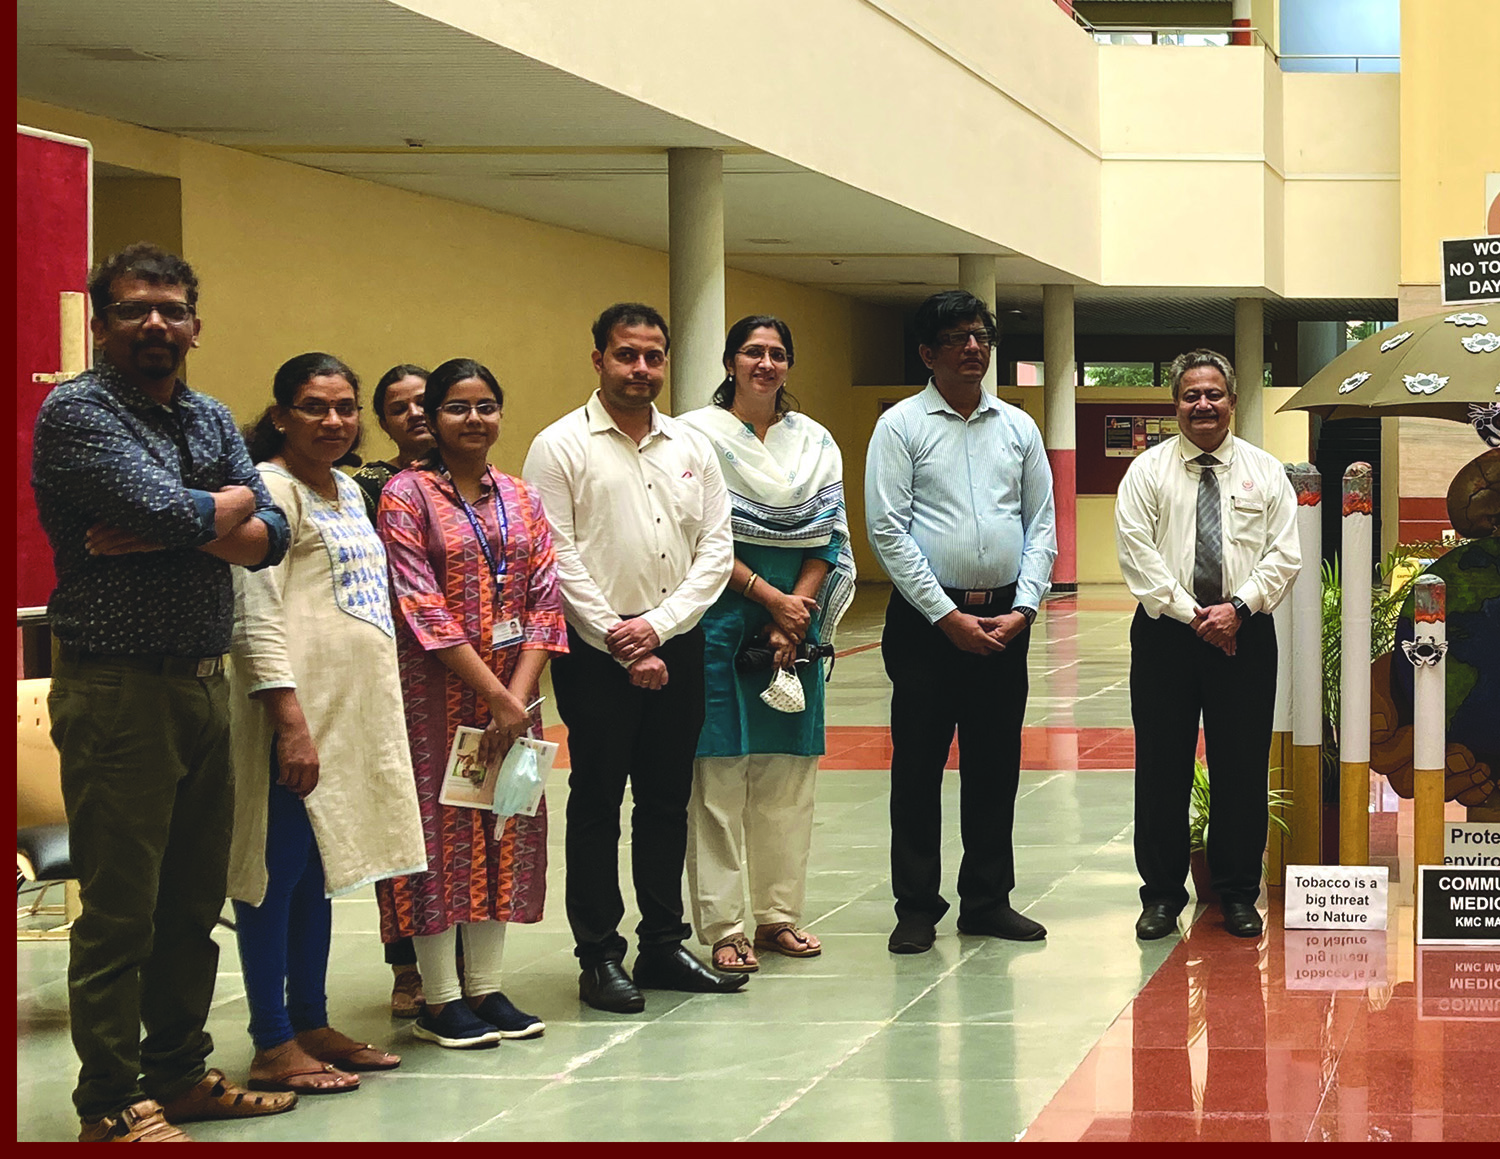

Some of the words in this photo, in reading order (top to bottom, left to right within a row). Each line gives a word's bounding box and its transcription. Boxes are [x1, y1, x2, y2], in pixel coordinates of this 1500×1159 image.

[1449, 262, 1474, 276] NO
[1295, 876, 1350, 888] Tobacco
[1354, 877, 1366, 888] is
[1370, 880, 1377, 889] a
[1306, 894, 1326, 907] big
[1330, 894, 1369, 906] threat
[1306, 911, 1319, 922] to
[1323, 911, 1368, 923] Nature
[1455, 916, 1482, 928] KMC
